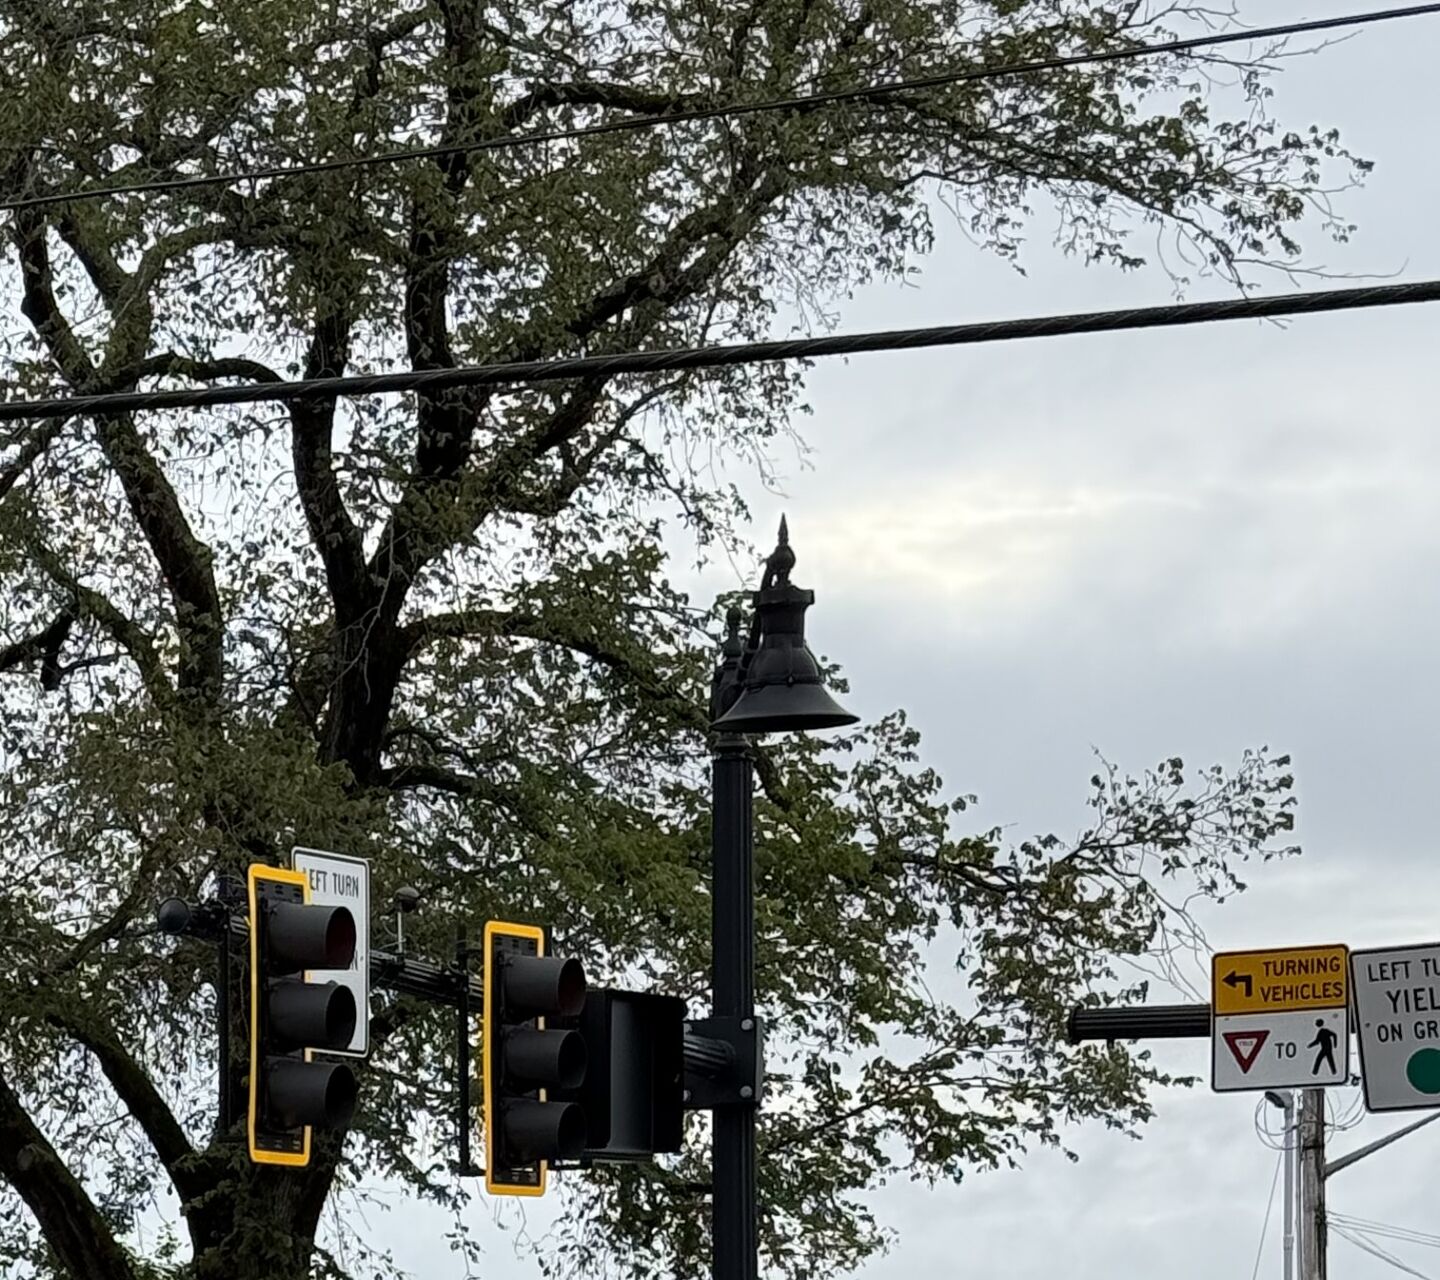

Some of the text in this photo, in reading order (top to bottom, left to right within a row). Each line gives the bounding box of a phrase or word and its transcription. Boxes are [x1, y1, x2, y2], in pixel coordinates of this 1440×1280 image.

[332, 873, 360, 898] TURN
[1263, 956, 1341, 977] TURNING
[1368, 961, 1412, 983] LEFT
[1261, 982, 1344, 1003] VEHICLES
[1377, 1023, 1404, 1043] ON
[1275, 1042, 1297, 1059] TO
